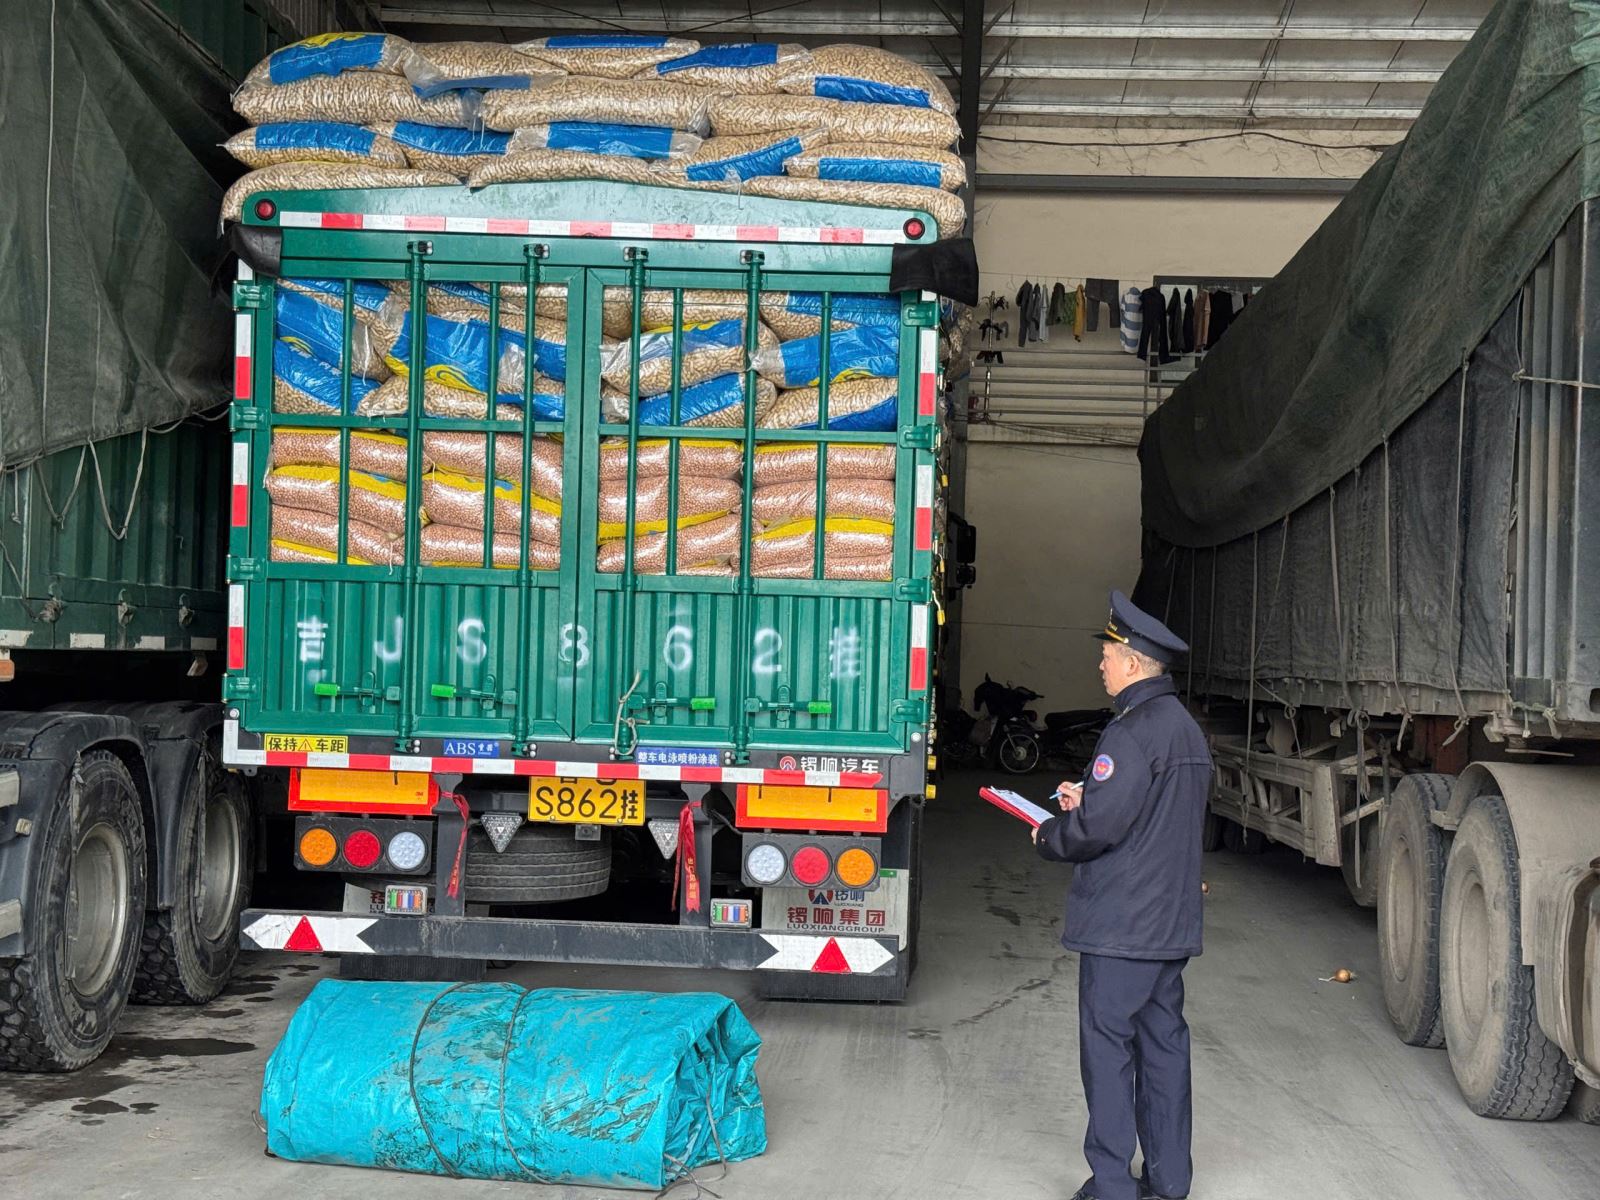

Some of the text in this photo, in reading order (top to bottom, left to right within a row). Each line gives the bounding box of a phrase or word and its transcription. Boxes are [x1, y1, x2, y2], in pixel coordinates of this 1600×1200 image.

[444, 742, 476, 755] ABS
[637, 751, 718, 765] 整车电泳喷粉涂装
[800, 756, 879, 774] 锣响汽车
[535, 786, 639, 819] S862挂
[787, 907, 885, 926] 锣响集团
[787, 923, 884, 933] LUOXIANGGROUP
